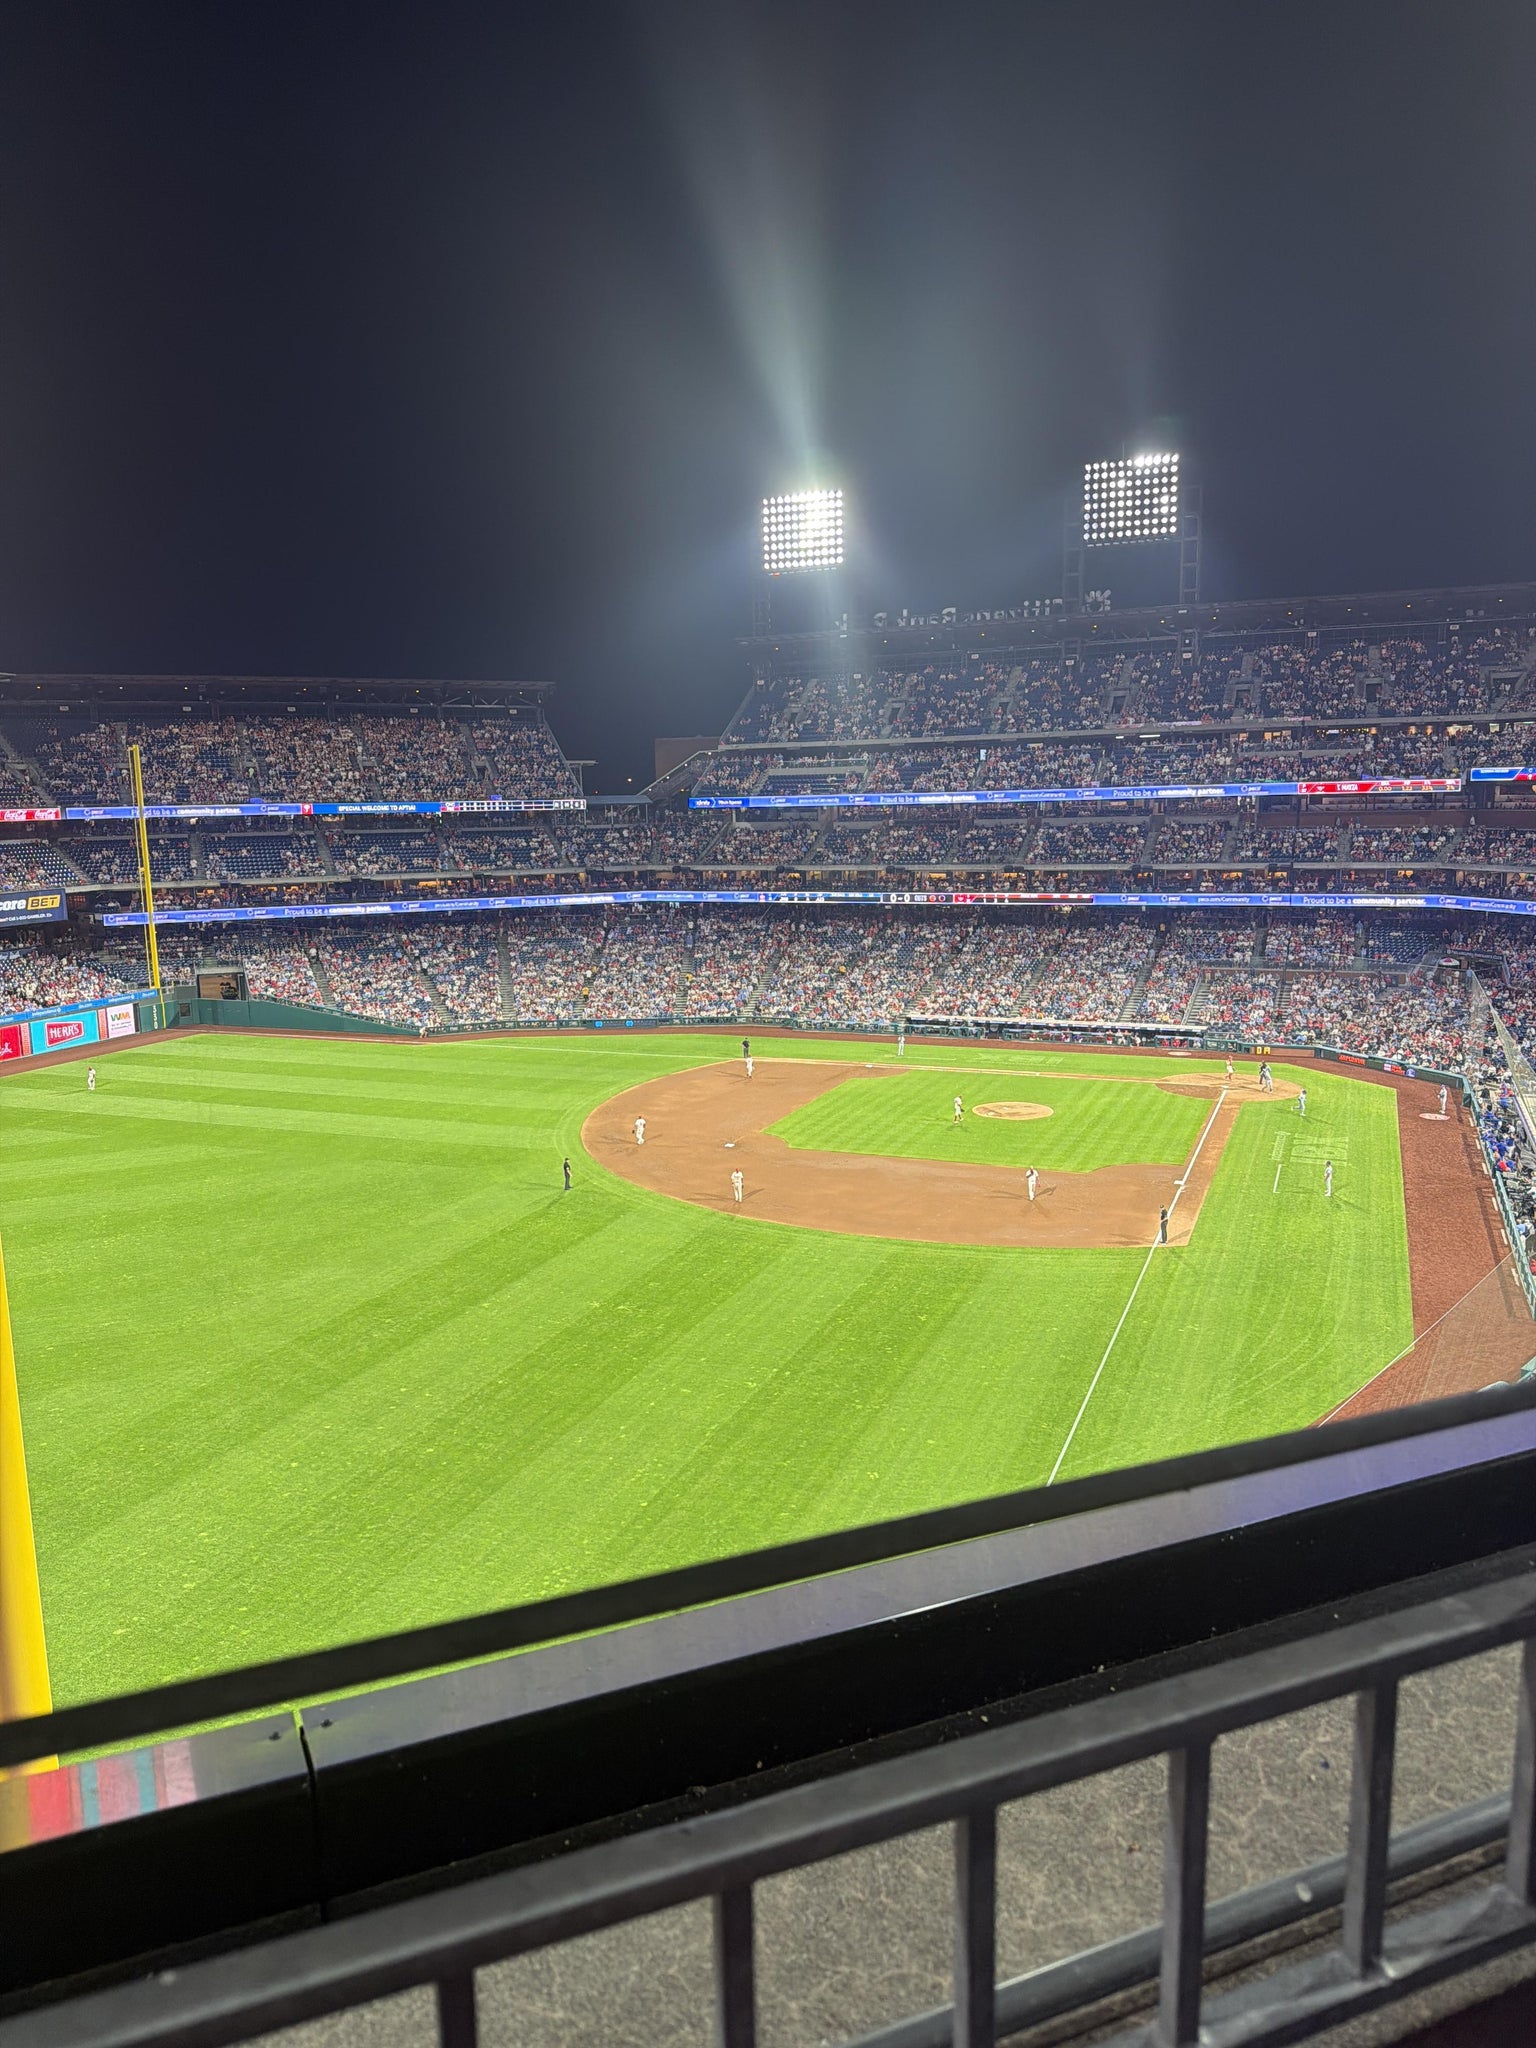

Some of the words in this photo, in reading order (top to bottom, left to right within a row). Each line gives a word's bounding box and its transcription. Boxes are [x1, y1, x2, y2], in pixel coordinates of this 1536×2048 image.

[1113, 789, 1133, 797] Proud
[1143, 788, 1151, 796] be
[1158, 787, 1196, 797] community
[1198, 787, 1225, 796] partner.
[131, 809, 152, 817] Prud
[30, 897, 59, 908] BET
[1303, 896, 1325, 905] Proud
[1326, 897, 1333, 905] to
[1335, 896, 1345, 905] be
[1353, 896, 1395, 907] community
[1396, 897, 1426, 907] partner.
[284, 908, 305, 917] Proud
[314, 907, 323, 915] be
[329, 906, 366, 916] community
[367, 905, 391, 914] partner.
[111, 1012, 131, 1022] WM
[49, 1024, 80, 1039] HERR'S
